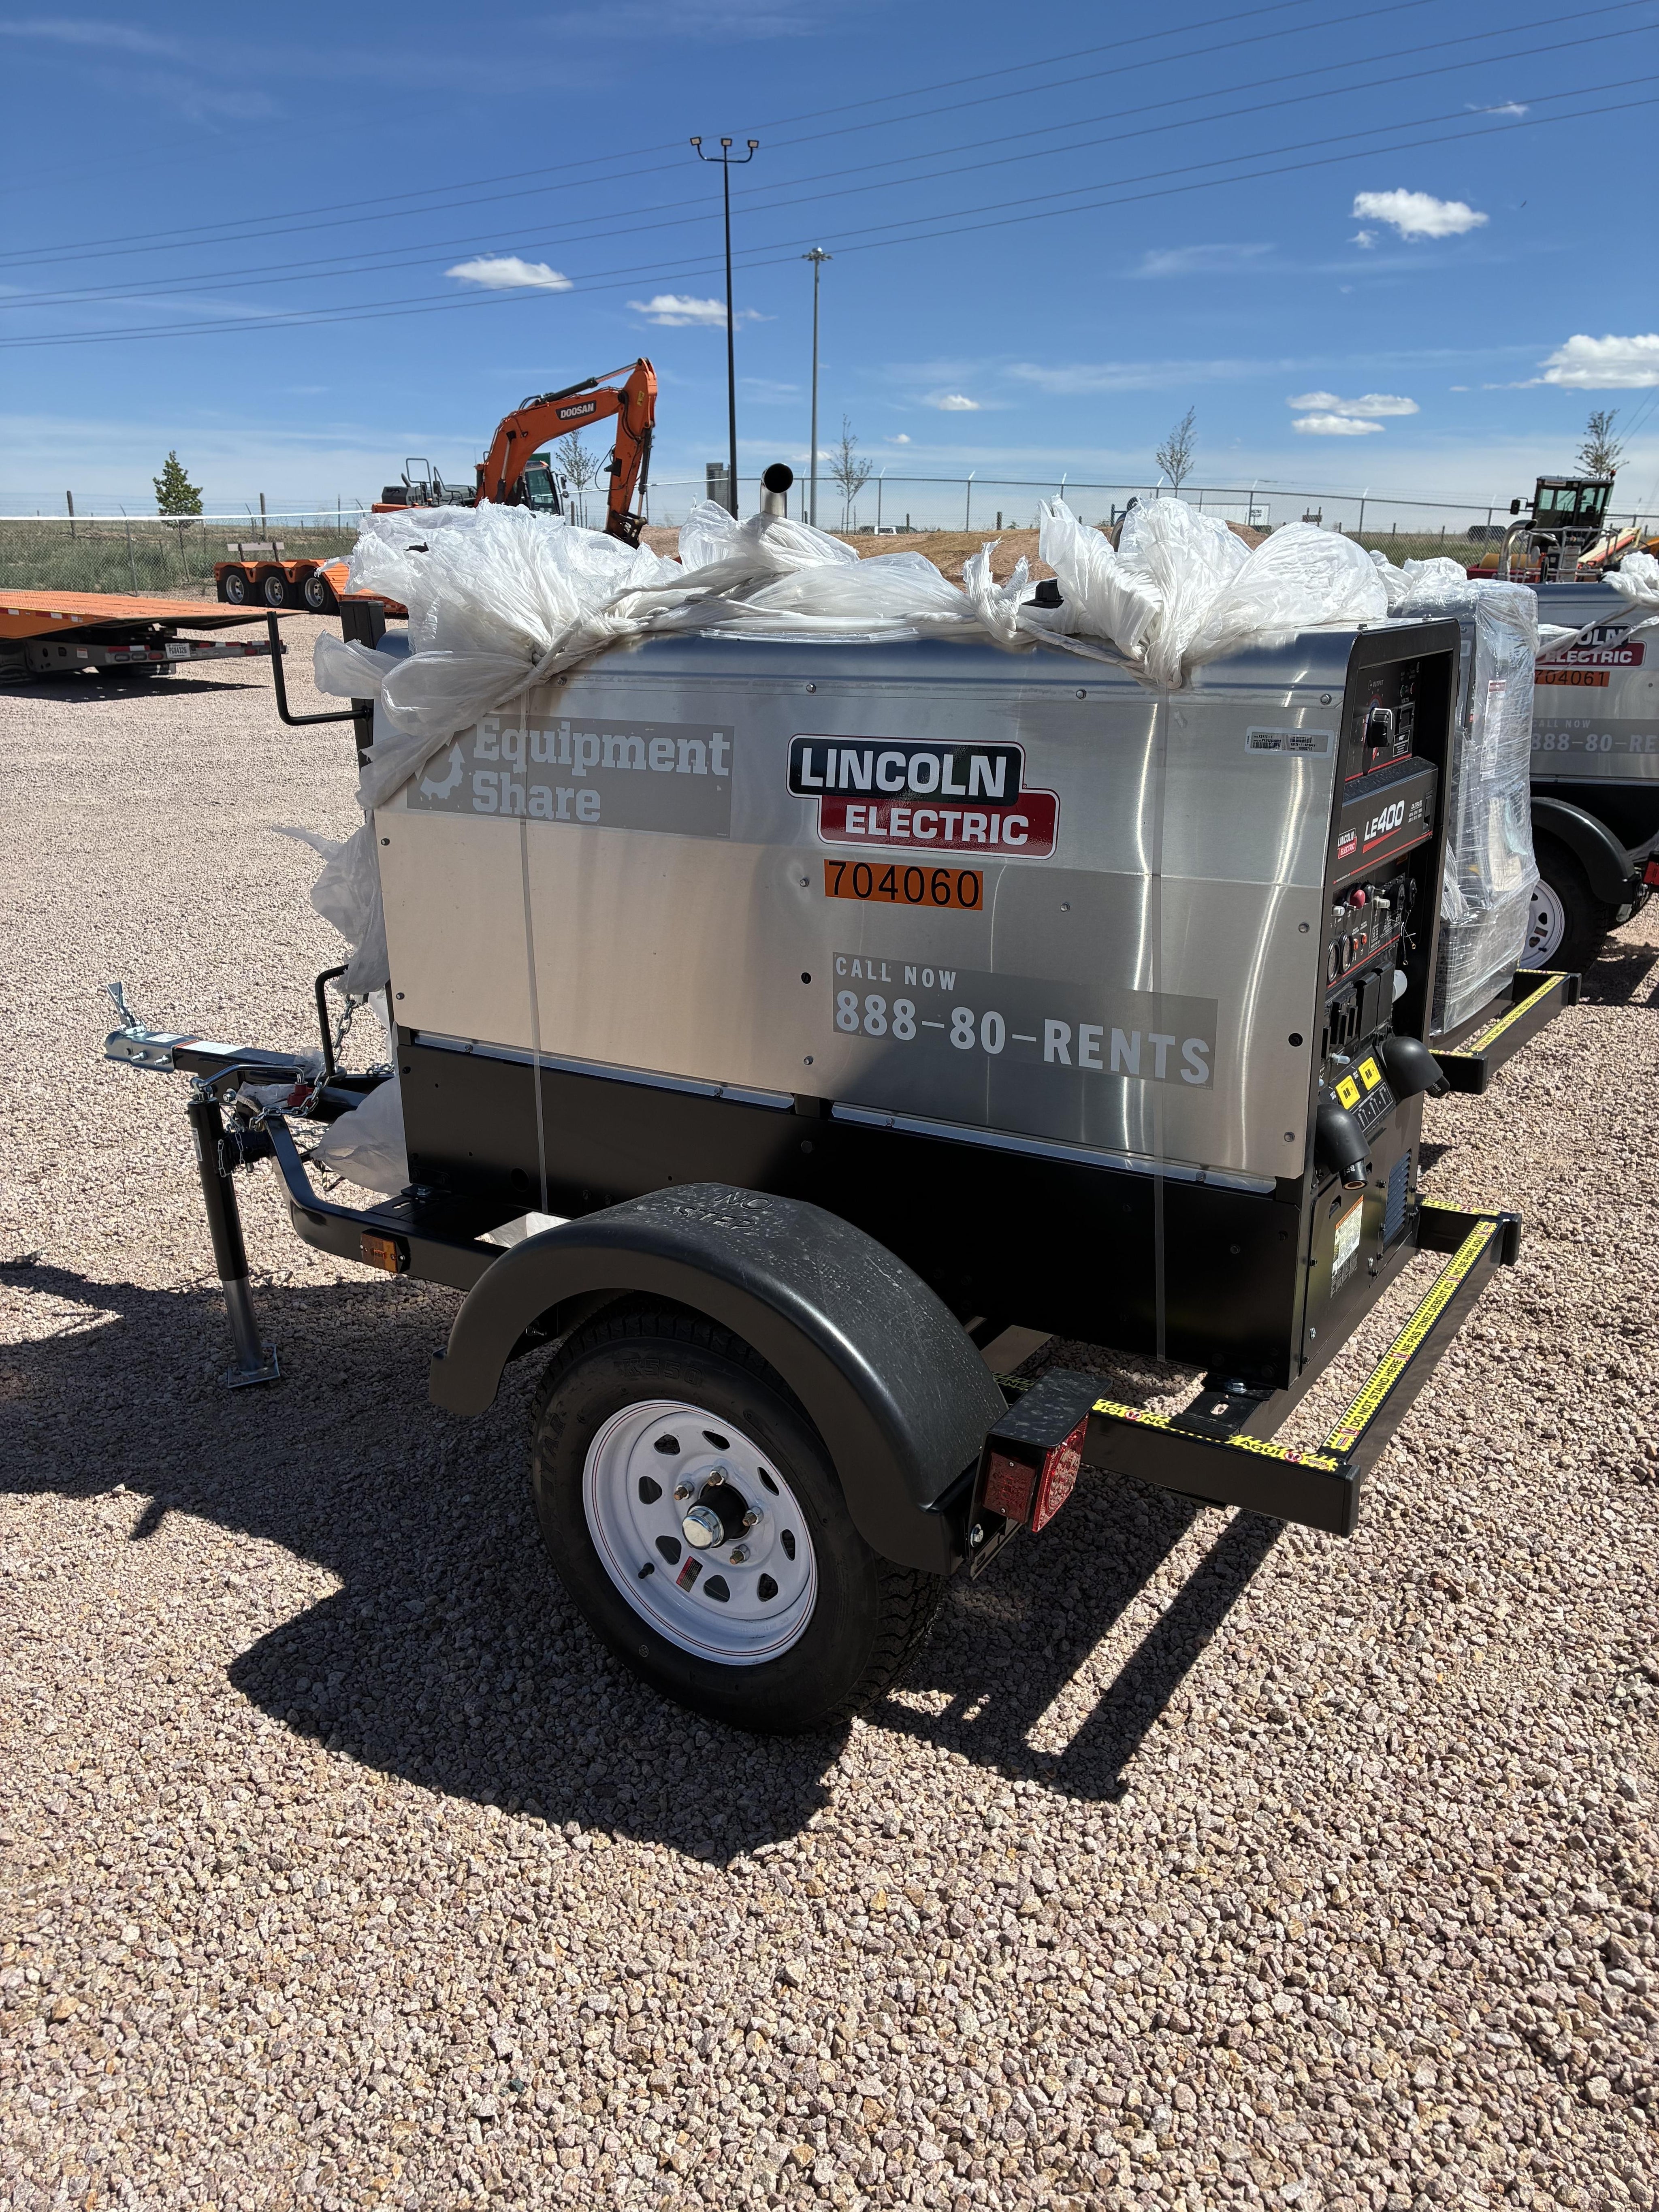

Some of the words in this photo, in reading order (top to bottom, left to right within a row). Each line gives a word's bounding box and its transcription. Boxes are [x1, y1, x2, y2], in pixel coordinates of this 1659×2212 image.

[560, 403, 594, 418] DOOSAN
[1532, 719, 1558, 728] CALL
[1565, 720, 1591, 728] NOW
[473, 717, 730, 776] Equipment
[801, 747, 1007, 798] LINCOLN
[473, 770, 601, 822] Share
[845, 804, 1029, 846] ELECTRIC
[1364, 800, 1405, 841] LE400
[1337, 831, 1354, 847] LINCOLN
[1340, 842, 1355, 856] ELECTRIC
[828, 861, 980, 908] 704060
[836, 957, 891, 983] CALL
[904, 966, 956, 991] NOW
[836, 990, 1210, 1085] 888-80-RENTS
[677, 1206, 756, 1230] STEP
[714, 1192, 774, 1211] NO
[1452, 1268, 1463, 1276] NO
[1463, 1248, 1477, 1261] PARE
[1400, 1343, 1413, 1352] NE
[1407, 1331, 1422, 1343] PAS
[1415, 1312, 1434, 1330] TENEZ
[1428, 1289, 1449, 1312] DEBOUT
[1443, 1282, 1454, 1290] ICI
[1101, 1405, 1122, 1414] ICI
[1349, 1416, 1364, 1427] DO
[1358, 1399, 1375, 1416] NOT
[1368, 1378, 1390, 1400] STAND
[1384, 1359, 1402, 1377] HERE
[1143, 1416, 1167, 1425] NO
